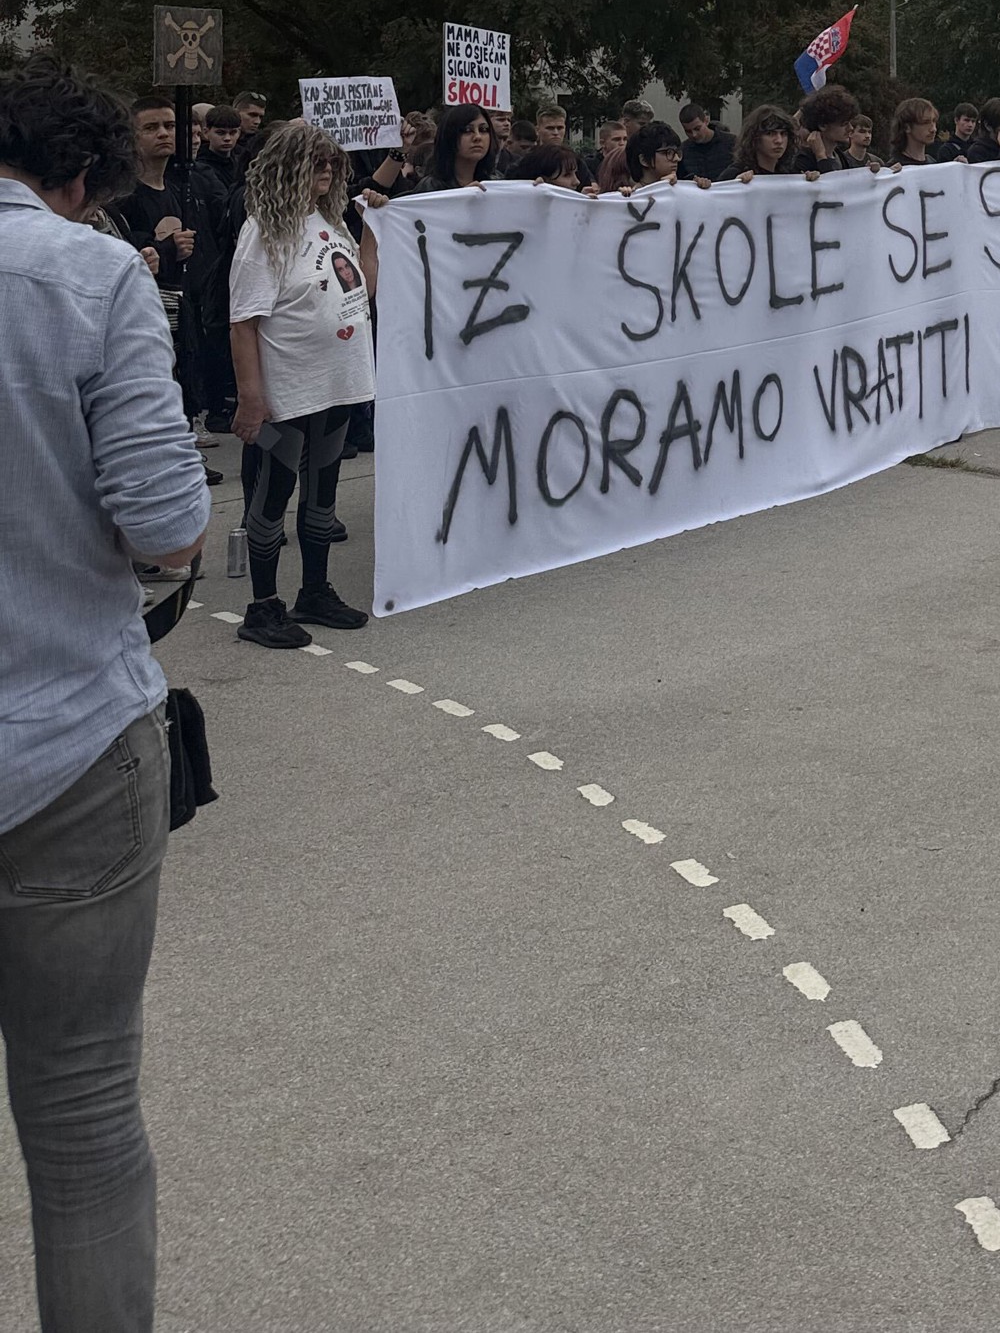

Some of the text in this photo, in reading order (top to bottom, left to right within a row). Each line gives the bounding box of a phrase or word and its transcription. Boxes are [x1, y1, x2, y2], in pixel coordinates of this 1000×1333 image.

[447, 25, 506, 50] MAMA JA SE
[447, 42, 507, 65] NE OSJEĆAM
[447, 59, 501, 82] SIGURNO U
[304, 86, 320, 102] KAD
[323, 82, 347, 101] ŠKOLA
[447, 77, 500, 108] ŠKOLI.
[315, 242, 339, 271] PRAVDA ZA
[618, 197, 844, 342] ŠKOLE
[882, 186, 952, 283] SE
[435, 369, 784, 544] MORAMO
[813, 312, 970, 433] VRATITI
